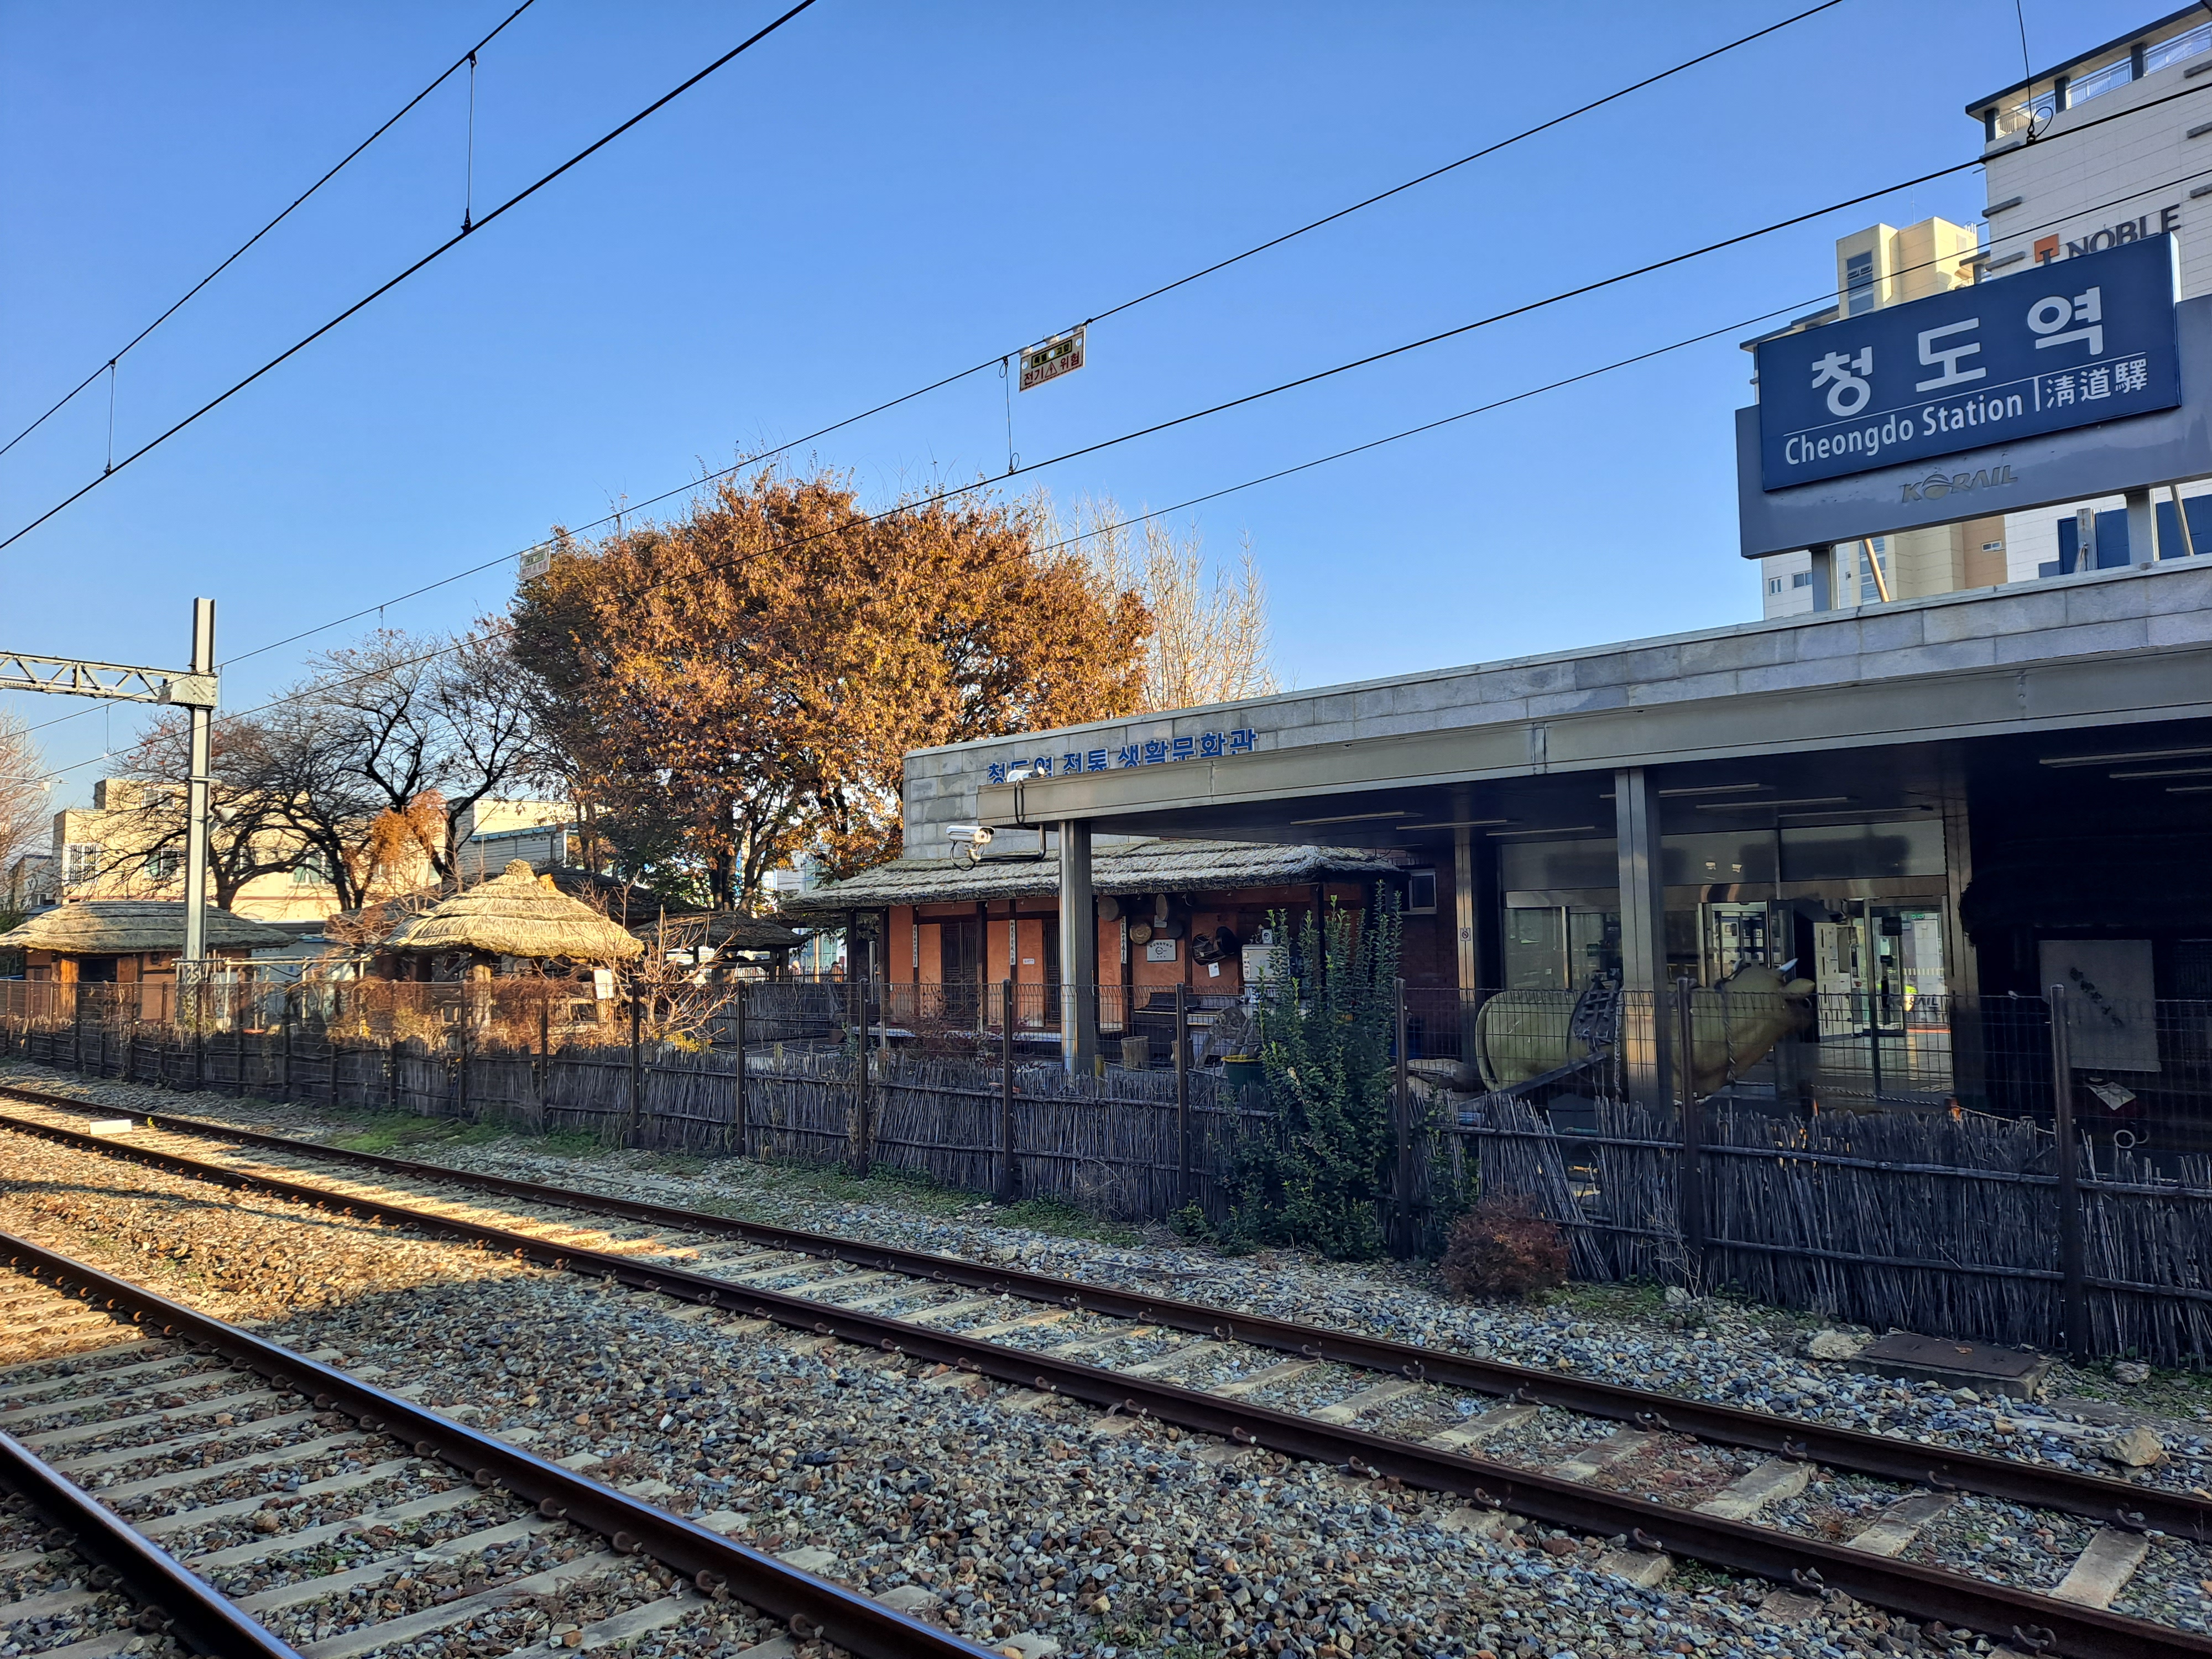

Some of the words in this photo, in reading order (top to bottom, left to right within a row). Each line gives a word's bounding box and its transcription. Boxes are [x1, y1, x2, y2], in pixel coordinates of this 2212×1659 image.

[2066, 204, 2181, 258] NOBLE
[1024, 367, 1044, 385] 전기
[1060, 351, 1079, 370] 위험
[1812, 285, 2104, 416] 청도역
[1785, 415, 1913, 466] Cheongdo
[1923, 393, 2023, 437] Station
[1901, 465, 2018, 503] KORAIL
[1118, 728, 1258, 768] 생활문화관
